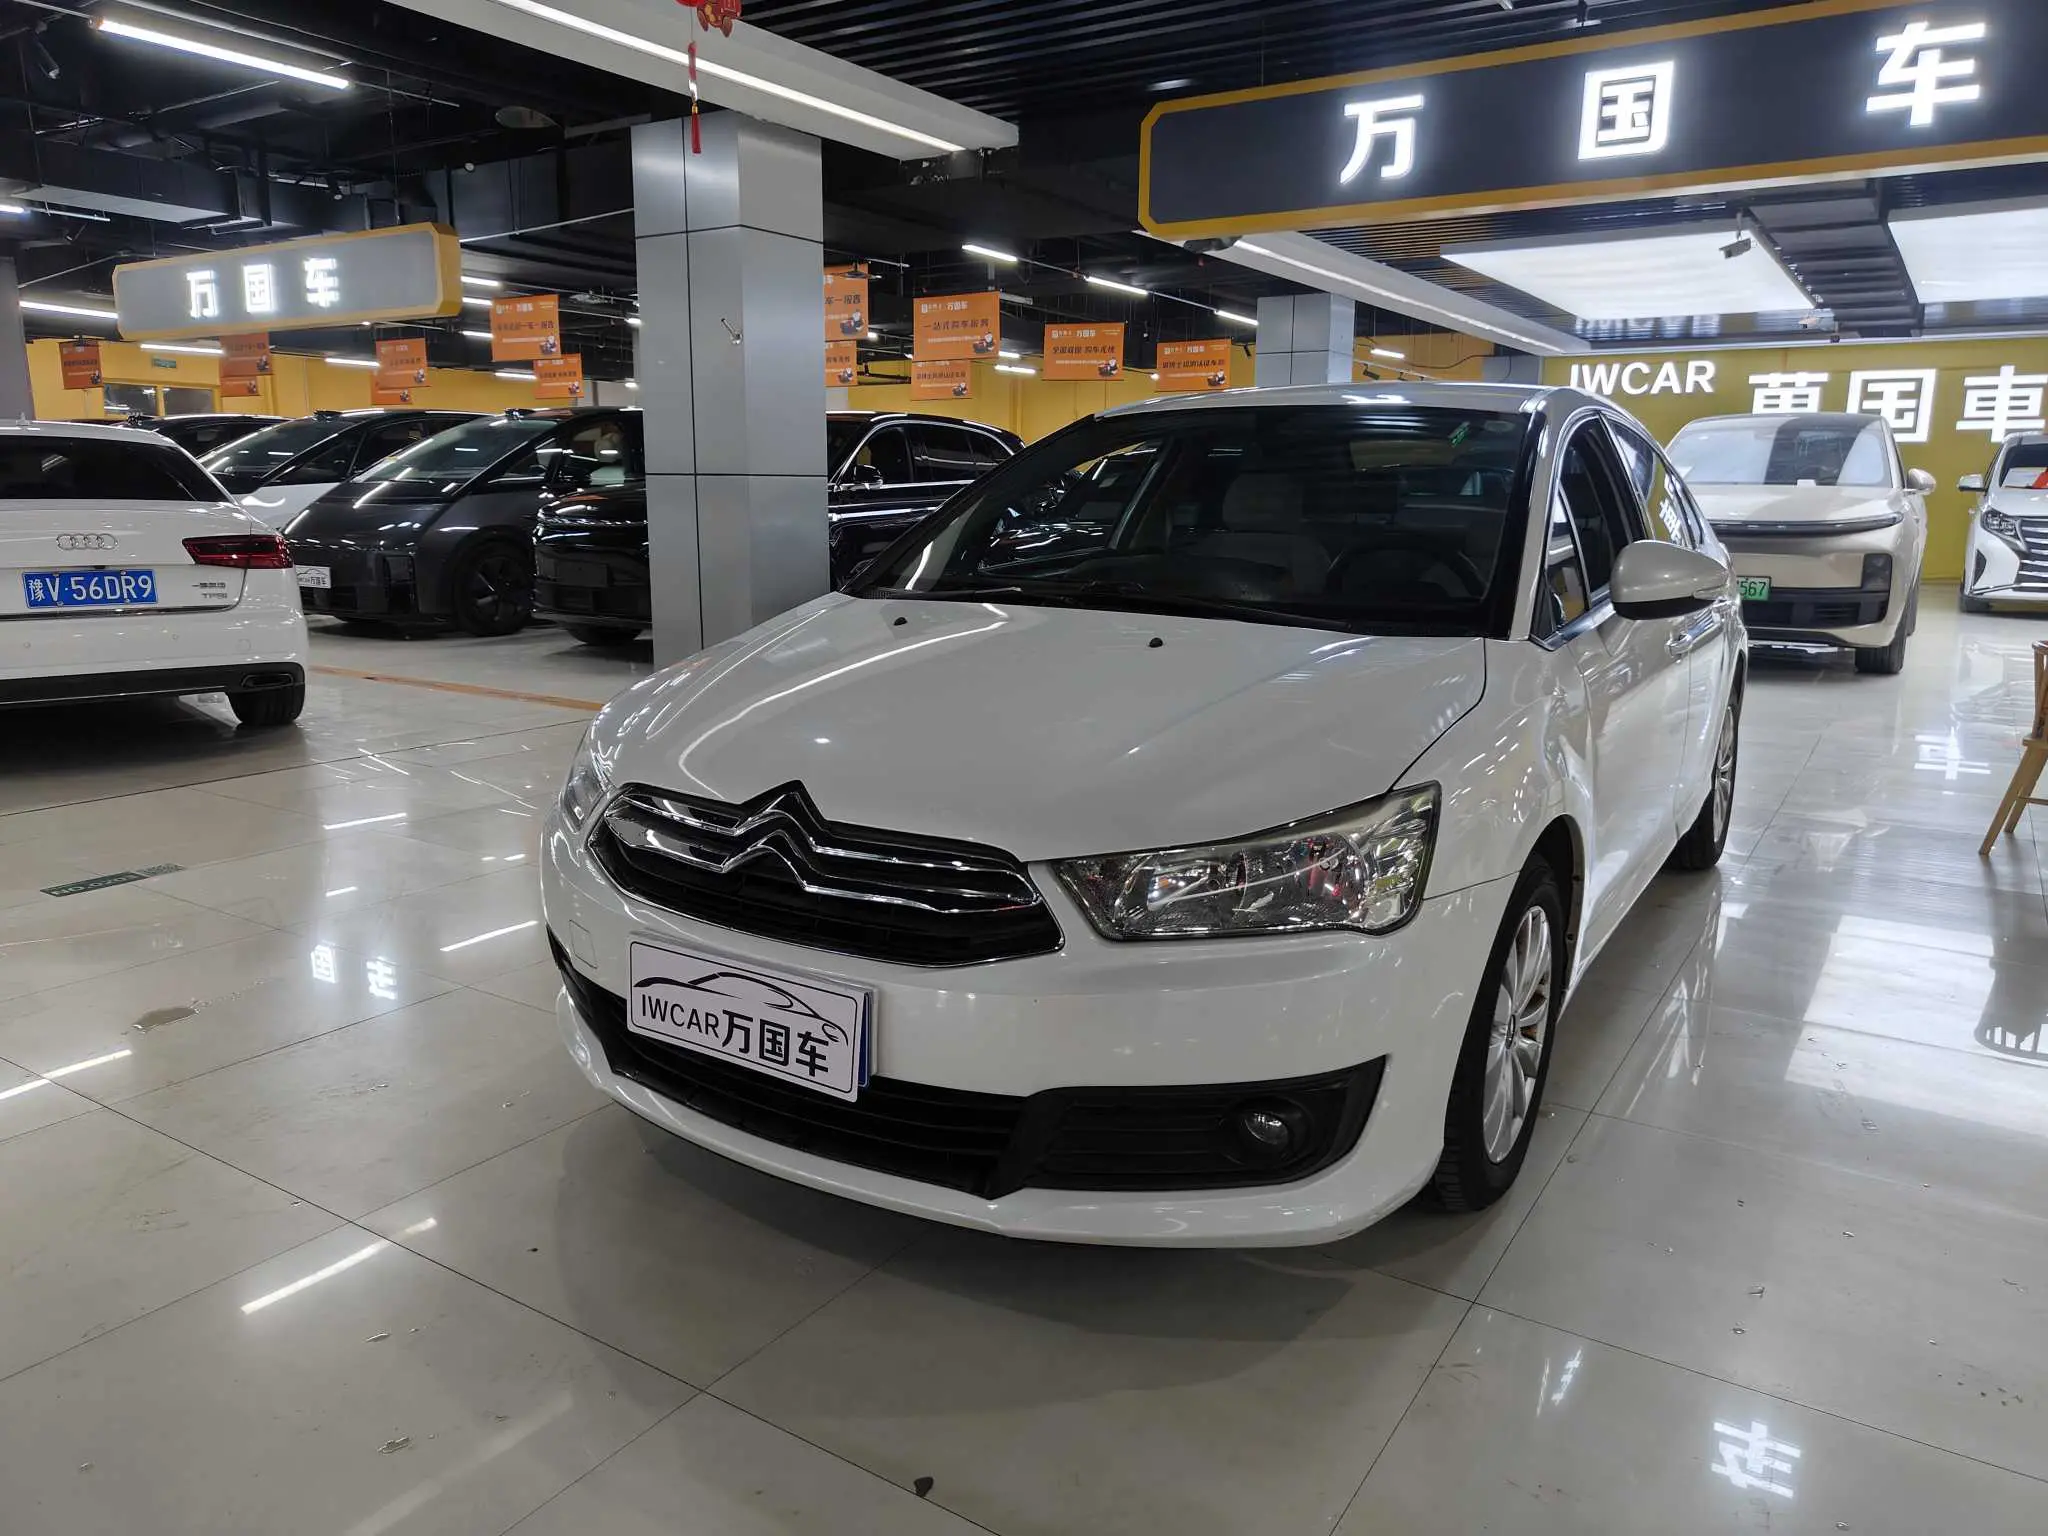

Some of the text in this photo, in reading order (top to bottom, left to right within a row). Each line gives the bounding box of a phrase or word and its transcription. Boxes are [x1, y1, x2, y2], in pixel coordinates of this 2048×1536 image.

[1339, 21, 1986, 185] 万国车
[186, 257, 340, 318] 万国车
[1570, 360, 1716, 396] IWCAR
[1737, 580, 1767, 597] 567
